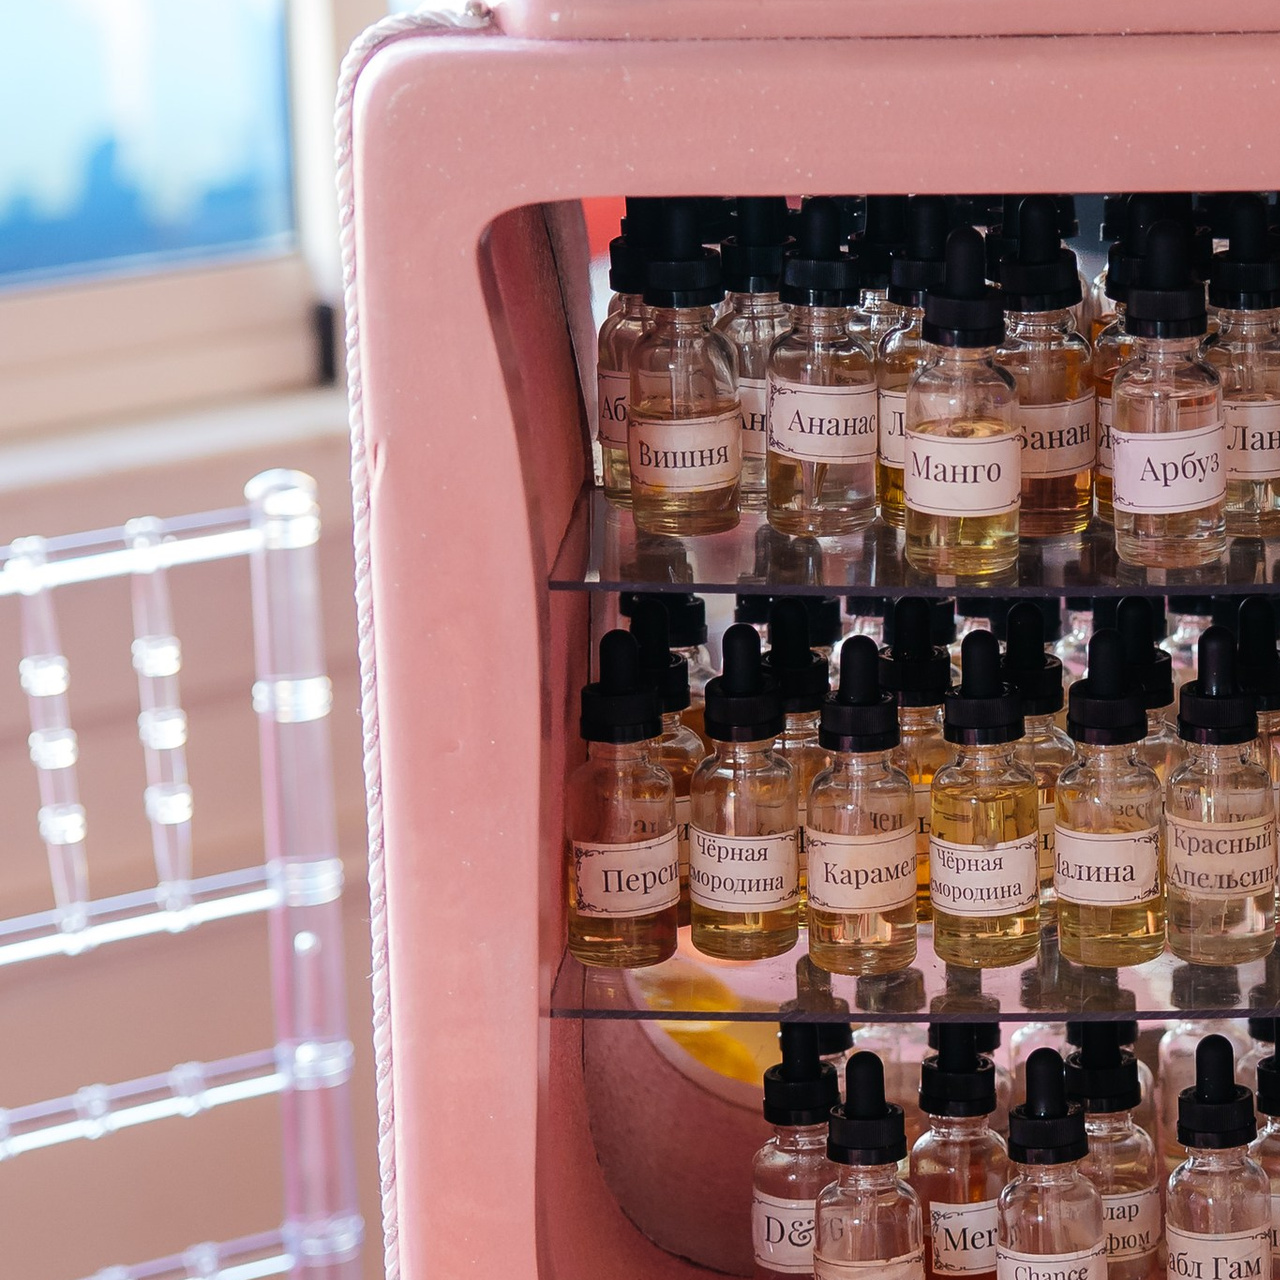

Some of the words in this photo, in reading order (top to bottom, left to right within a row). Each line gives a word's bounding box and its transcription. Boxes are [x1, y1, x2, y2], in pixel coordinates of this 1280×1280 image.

[788, 409, 876, 436] Ананас
[639, 439, 729, 469] Вишня
[911, 451, 1001, 483] Манго
[1140, 451, 1220, 487] Арбуз
[696, 834, 769, 862] Чёрная
[1174, 824, 1272, 856] Красный
[937, 848, 1004, 874] Чёрная
[1171, 862, 1274, 889] Апельсин
[1169, 1251, 1203, 1279] абл
[1212, 1256, 1262, 1280] Гам
